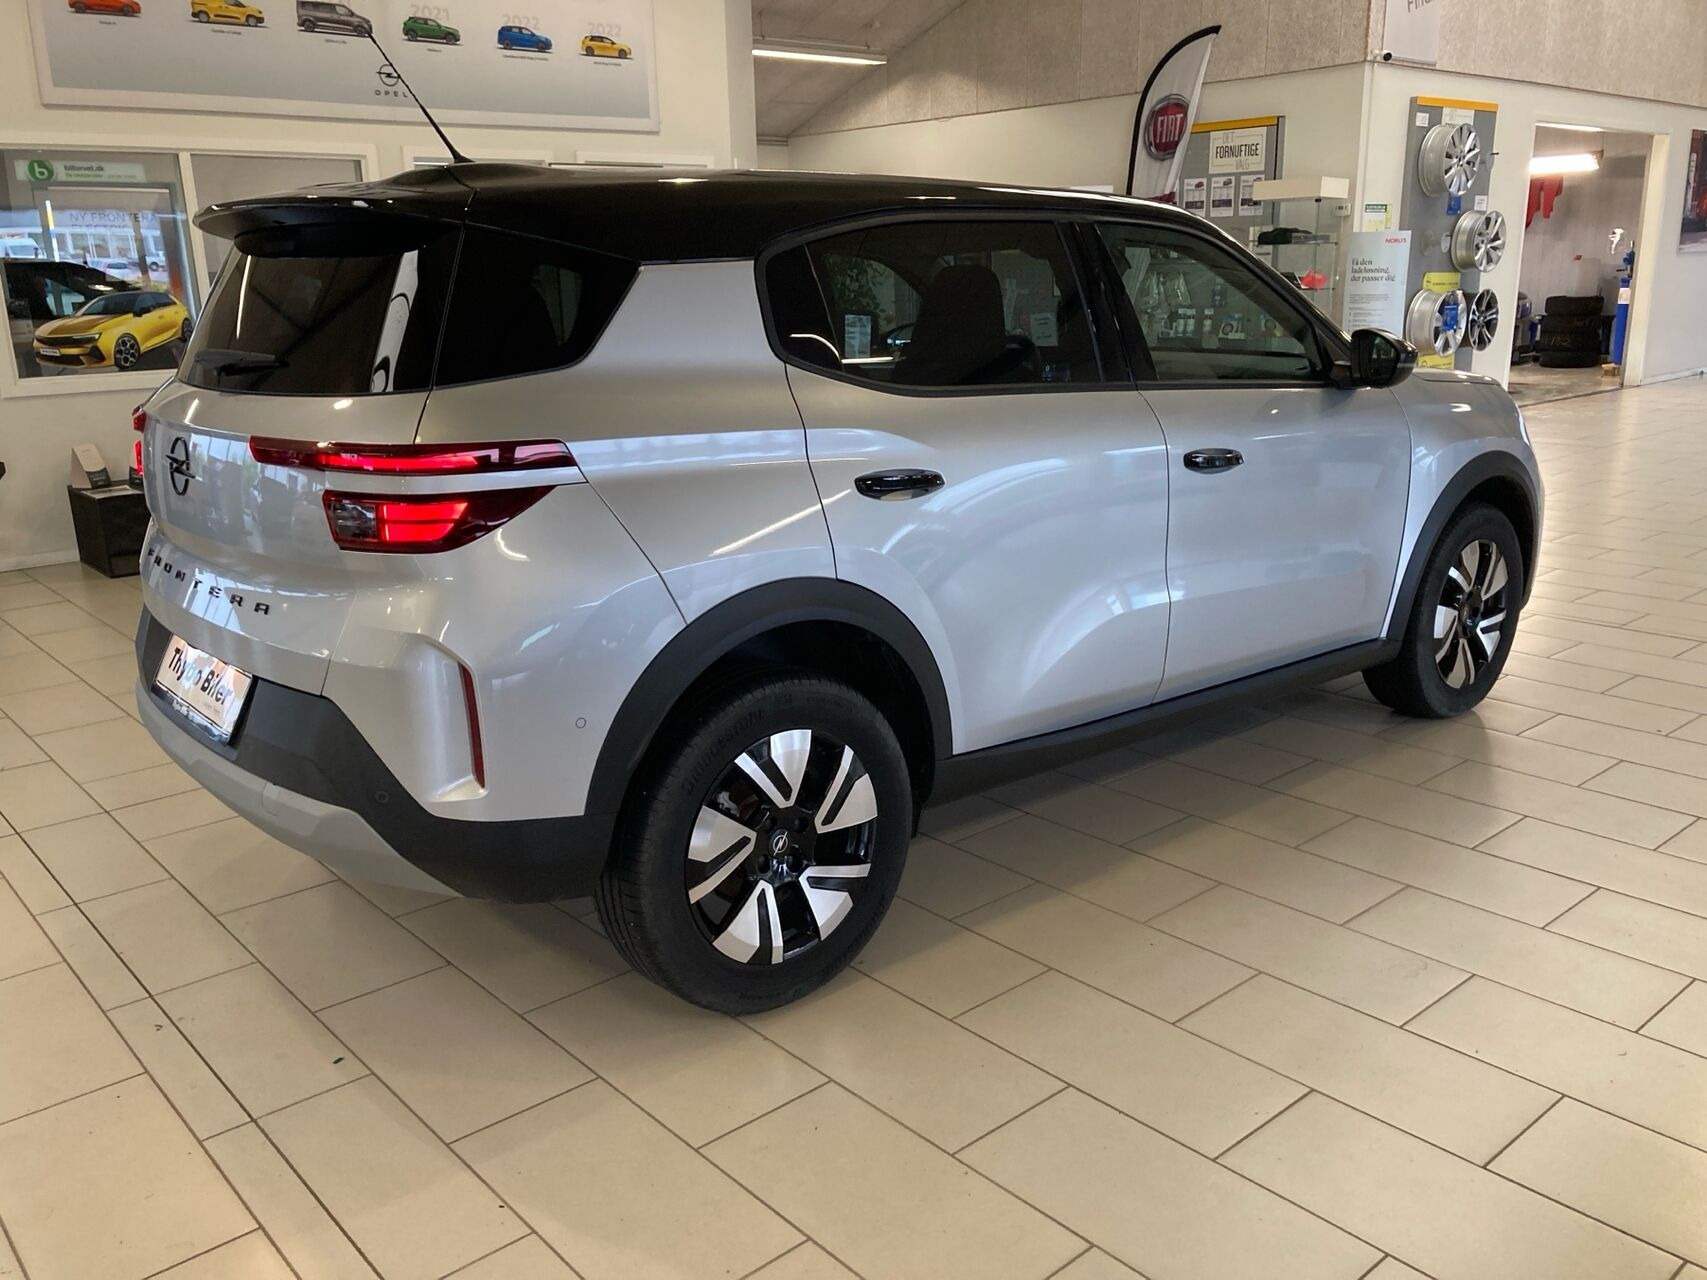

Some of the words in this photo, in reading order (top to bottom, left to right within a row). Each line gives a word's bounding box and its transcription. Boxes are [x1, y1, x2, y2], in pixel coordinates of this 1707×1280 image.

[374, 89, 408, 98] OPEL
[1156, 114, 1184, 144] FIAT
[1215, 143, 1260, 159] FORNUFTIGE
[70, 212, 87, 222] NY
[1360, 258, 1373, 266] den
[1361, 275, 1384, 284] passer
[147, 548, 270, 615] FRONTERA
[200, 669, 234, 706] Biler
